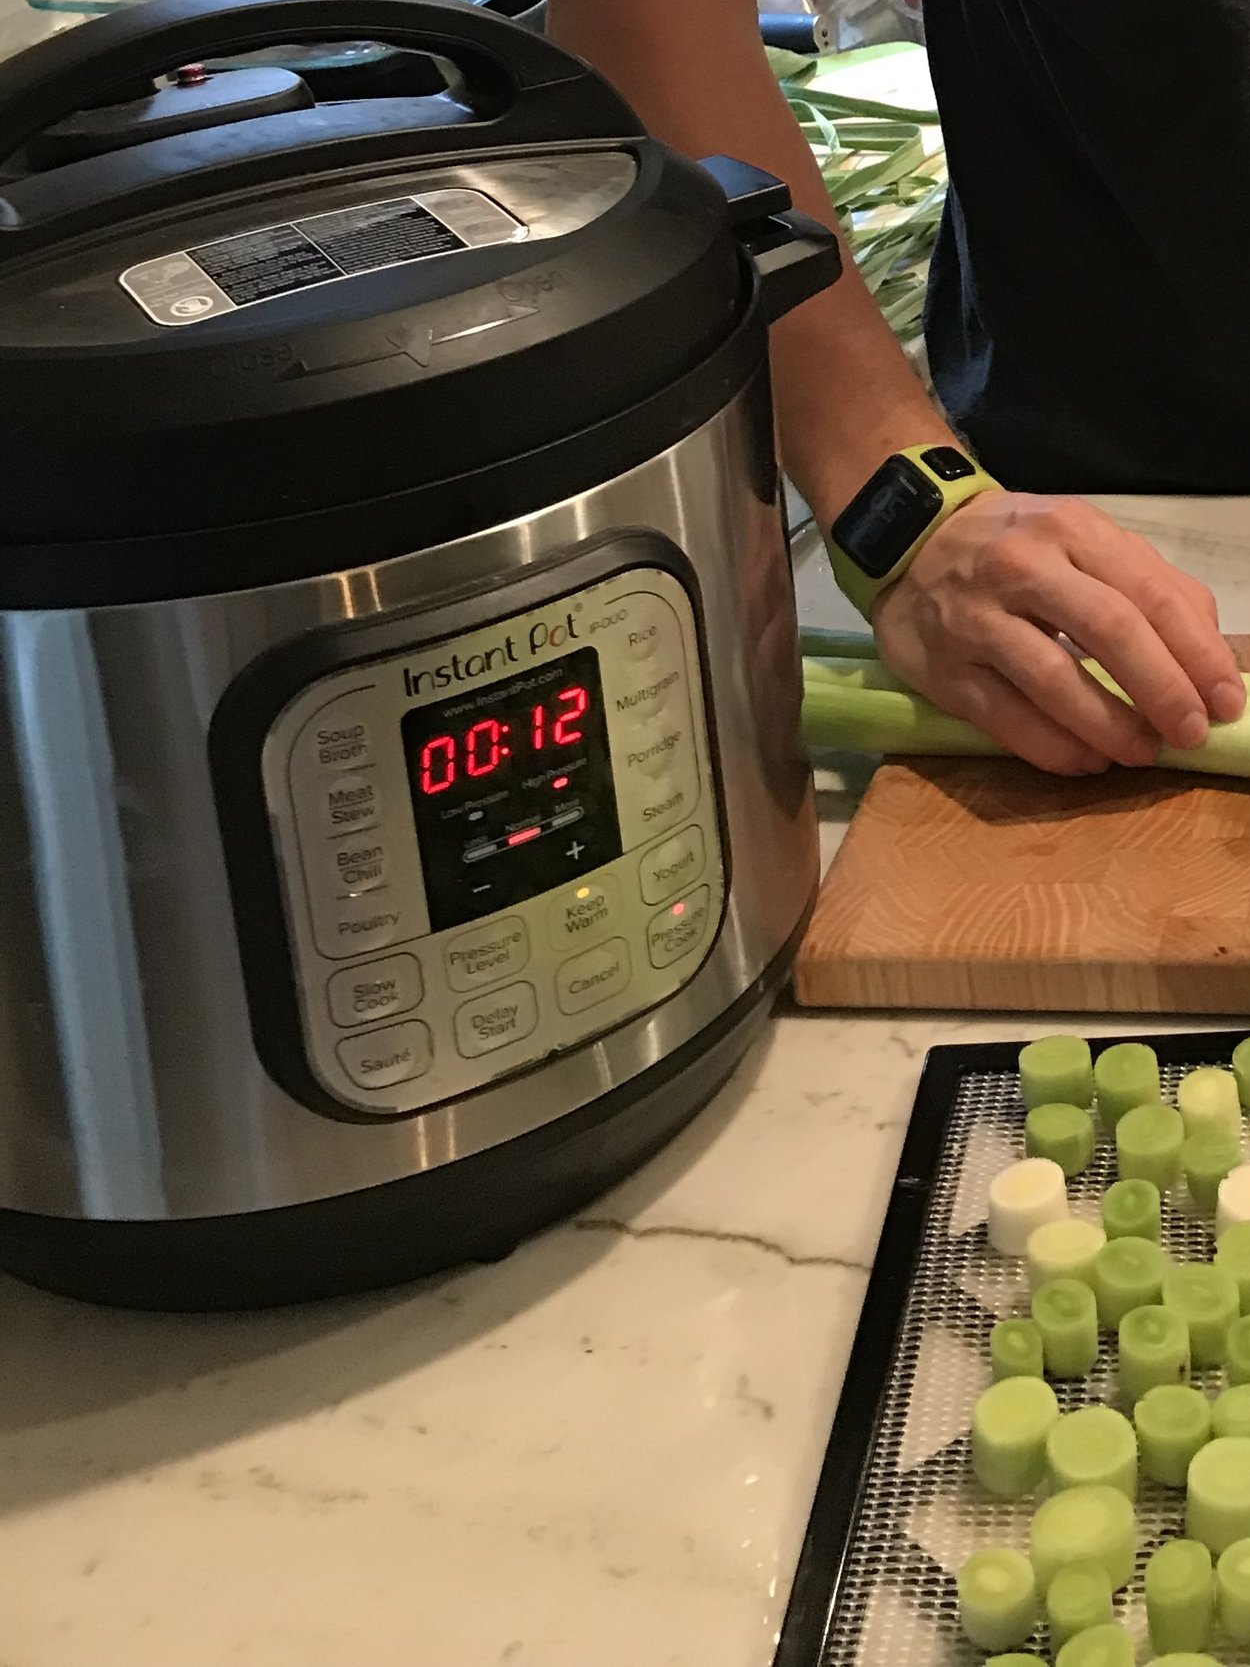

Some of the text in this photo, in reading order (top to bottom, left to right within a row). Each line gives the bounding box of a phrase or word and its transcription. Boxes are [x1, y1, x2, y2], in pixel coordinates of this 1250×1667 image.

[628, 625, 658, 647] Rice
[403, 614, 579, 697] Instant Pot
[443, 667, 564, 718] www.InstantPot.com
[616, 671, 680, 712] Multigrain
[317, 724, 365, 745] Soup
[421, 686, 588, 795] 00:12
[319, 743, 368, 764] Broth
[627, 731, 682, 767] Porridge
[328, 784, 374, 806] Meat
[642, 791, 684, 822] Steam
[331, 805, 376, 824] Stew
[336, 845, 384, 867] Bean
[653, 850, 695, 882] Yogurt
[342, 863, 383, 884] Chili
[566, 895, 605, 919] Keep
[338, 911, 400, 935] Poultry
[564, 908, 608, 933] Warm
[651, 906, 704, 947] Pressure
[450, 932, 522, 965] Pressure
[664, 927, 698, 952] Cook
[466, 950, 510, 974] Level
[353, 979, 397, 999] Slow
[569, 961, 620, 994] Cancel
[353, 995, 400, 1013] Cook
[471, 1004, 519, 1030] Delay
[479, 1018, 517, 1040] Start
[360, 1046, 412, 1074] Sauté
